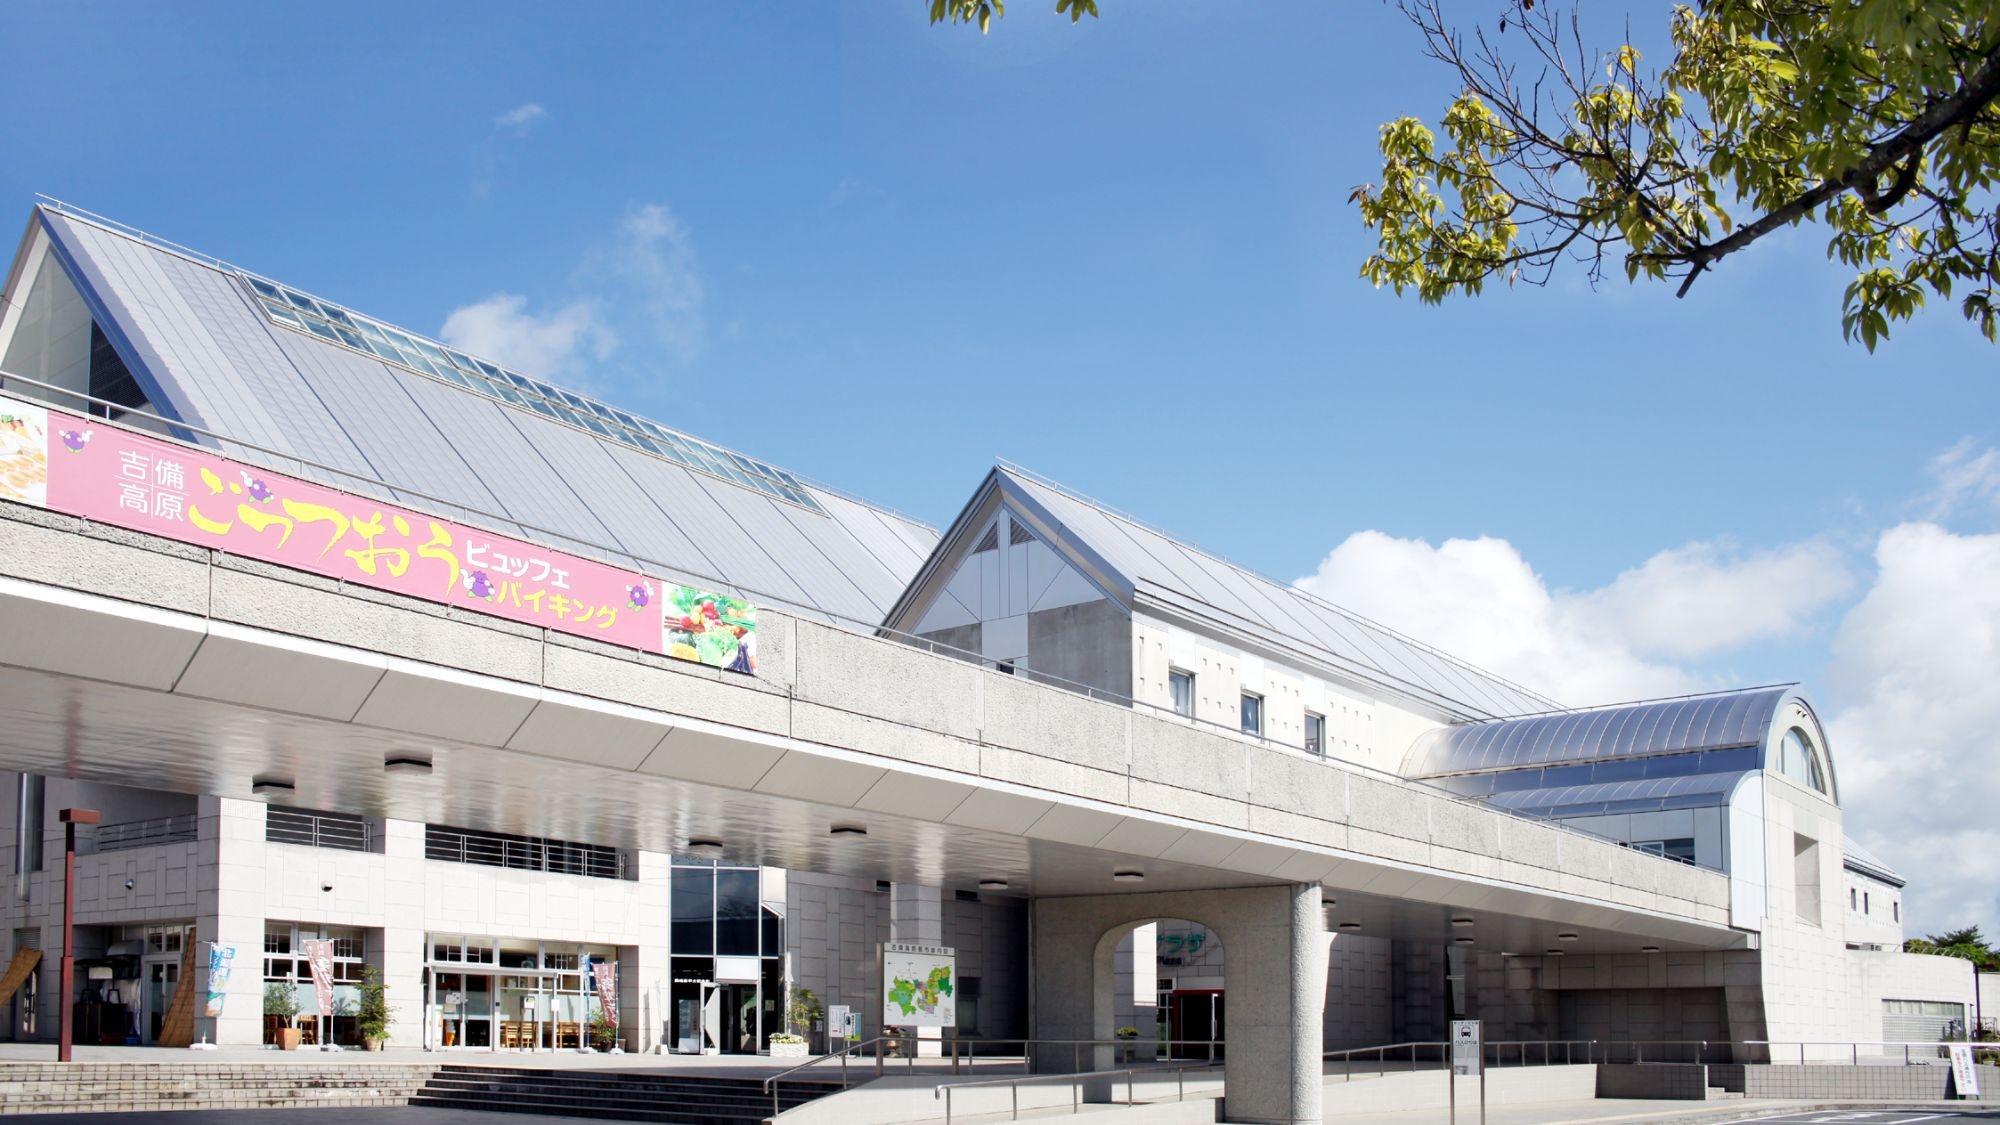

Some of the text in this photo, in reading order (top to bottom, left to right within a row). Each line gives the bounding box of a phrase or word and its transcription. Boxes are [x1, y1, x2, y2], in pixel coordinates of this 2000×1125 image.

[118, 450, 185, 490] 吉備
[119, 482, 185, 522] 高原
[465, 538, 571, 590] ビュッフェ
[497, 583, 619, 629] バイキング
